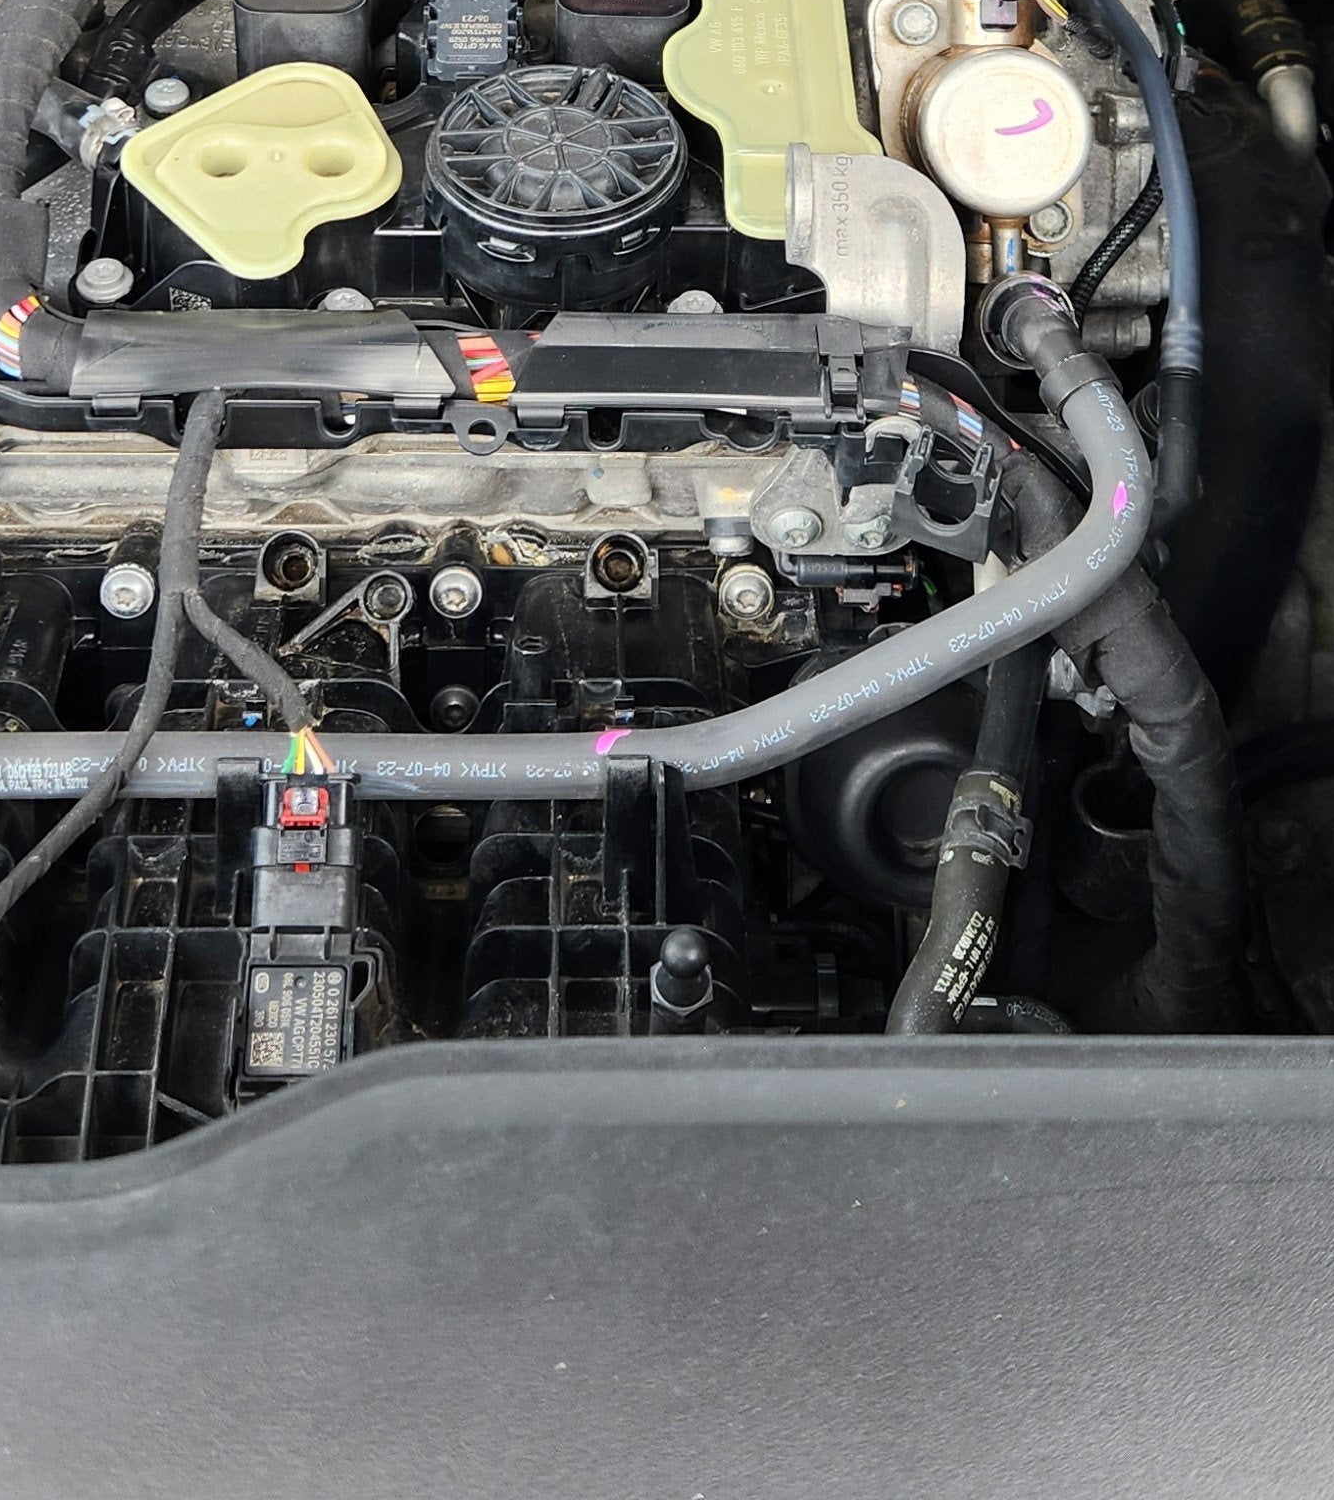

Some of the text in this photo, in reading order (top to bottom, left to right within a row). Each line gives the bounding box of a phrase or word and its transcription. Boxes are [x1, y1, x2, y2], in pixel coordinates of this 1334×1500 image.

[461, 14, 489, 22] 06/23
[708, 21, 722, 52] VW AG
[751, 12, 767, 44] Mexico
[731, 36, 745, 51] 103
[830, 151, 853, 256] max 350 kg
[947, 607, 1024, 654] 04-07-23
[885, 651, 935, 684] >TPV<
[808, 678, 882, 725] 04-07-23
[156, 756, 204, 772] >TPV<
[376, 760, 451, 776] 04-07-23
[460, 761, 505, 777] >TPV<
[975, 931, 989, 949] 122
[967, 945, 982, 963] 101
[327, 987, 340, 996] 0
[294, 997, 306, 1017] VW
[326, 999, 339, 1020] 261
[292, 1018, 305, 1034] AG
[324, 1023, 336, 1045] 230
